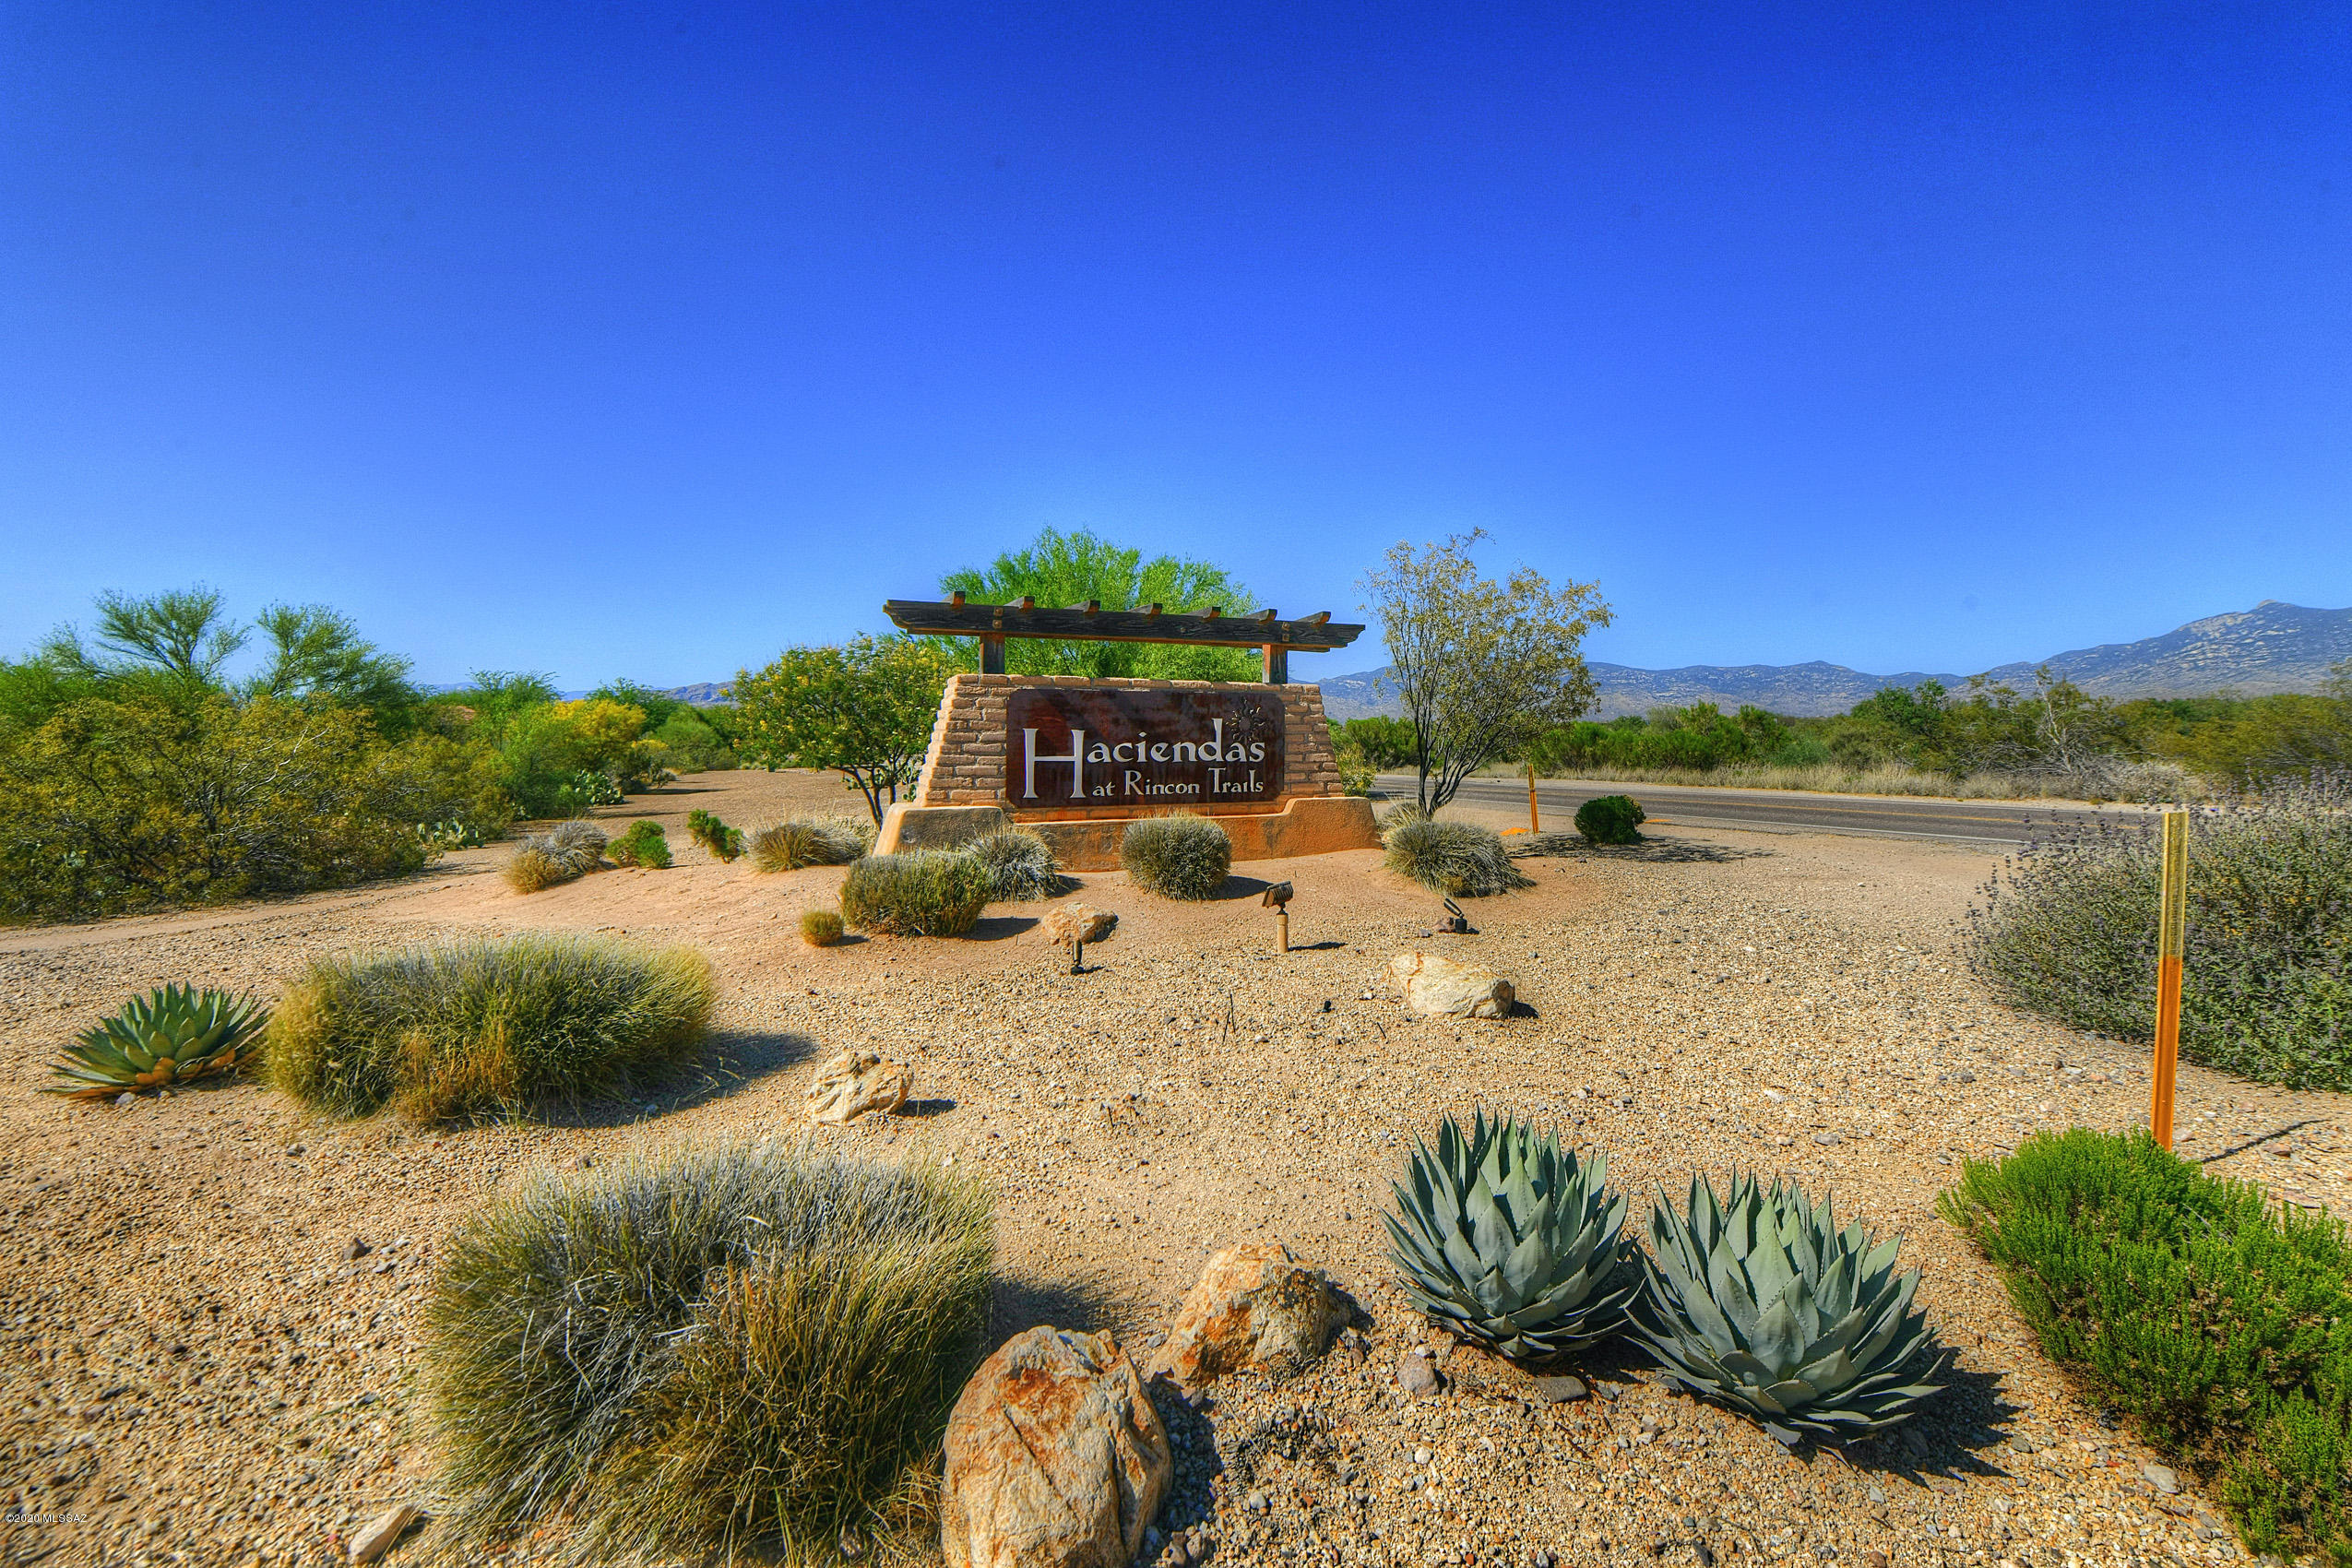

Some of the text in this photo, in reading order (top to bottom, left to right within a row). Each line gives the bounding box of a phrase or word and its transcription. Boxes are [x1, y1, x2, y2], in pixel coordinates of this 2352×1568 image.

[1022, 718, 1265, 799] Haciendas
[1092, 767, 1264, 797] at Rincon Trails
